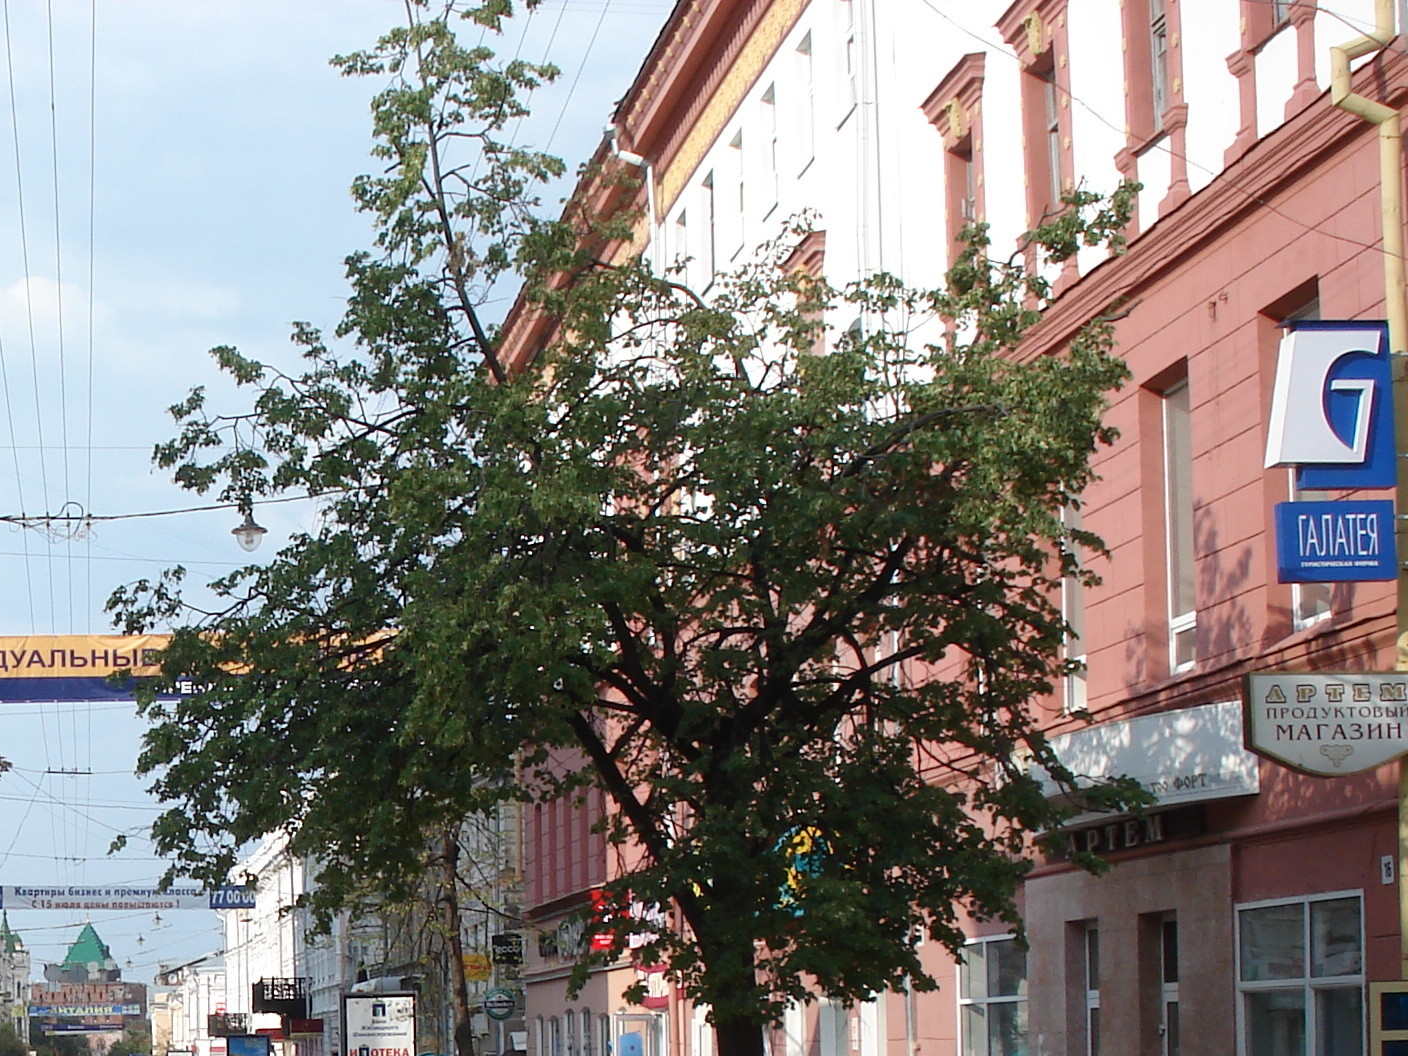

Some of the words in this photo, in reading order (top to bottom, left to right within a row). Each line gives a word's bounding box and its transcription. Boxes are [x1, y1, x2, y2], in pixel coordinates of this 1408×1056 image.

[1298, 513, 1379, 557] ГАЛАТЕЯ
[1265, 683, 1407, 704] АРТЕМ
[1275, 723, 1403, 741] МАГАЗИН
[1173, 773, 1206, 790] ФОРТ
[14, 886, 65, 898] Квартиры
[226, 890, 241, 904] 00
[41, 900, 52, 909] 15
